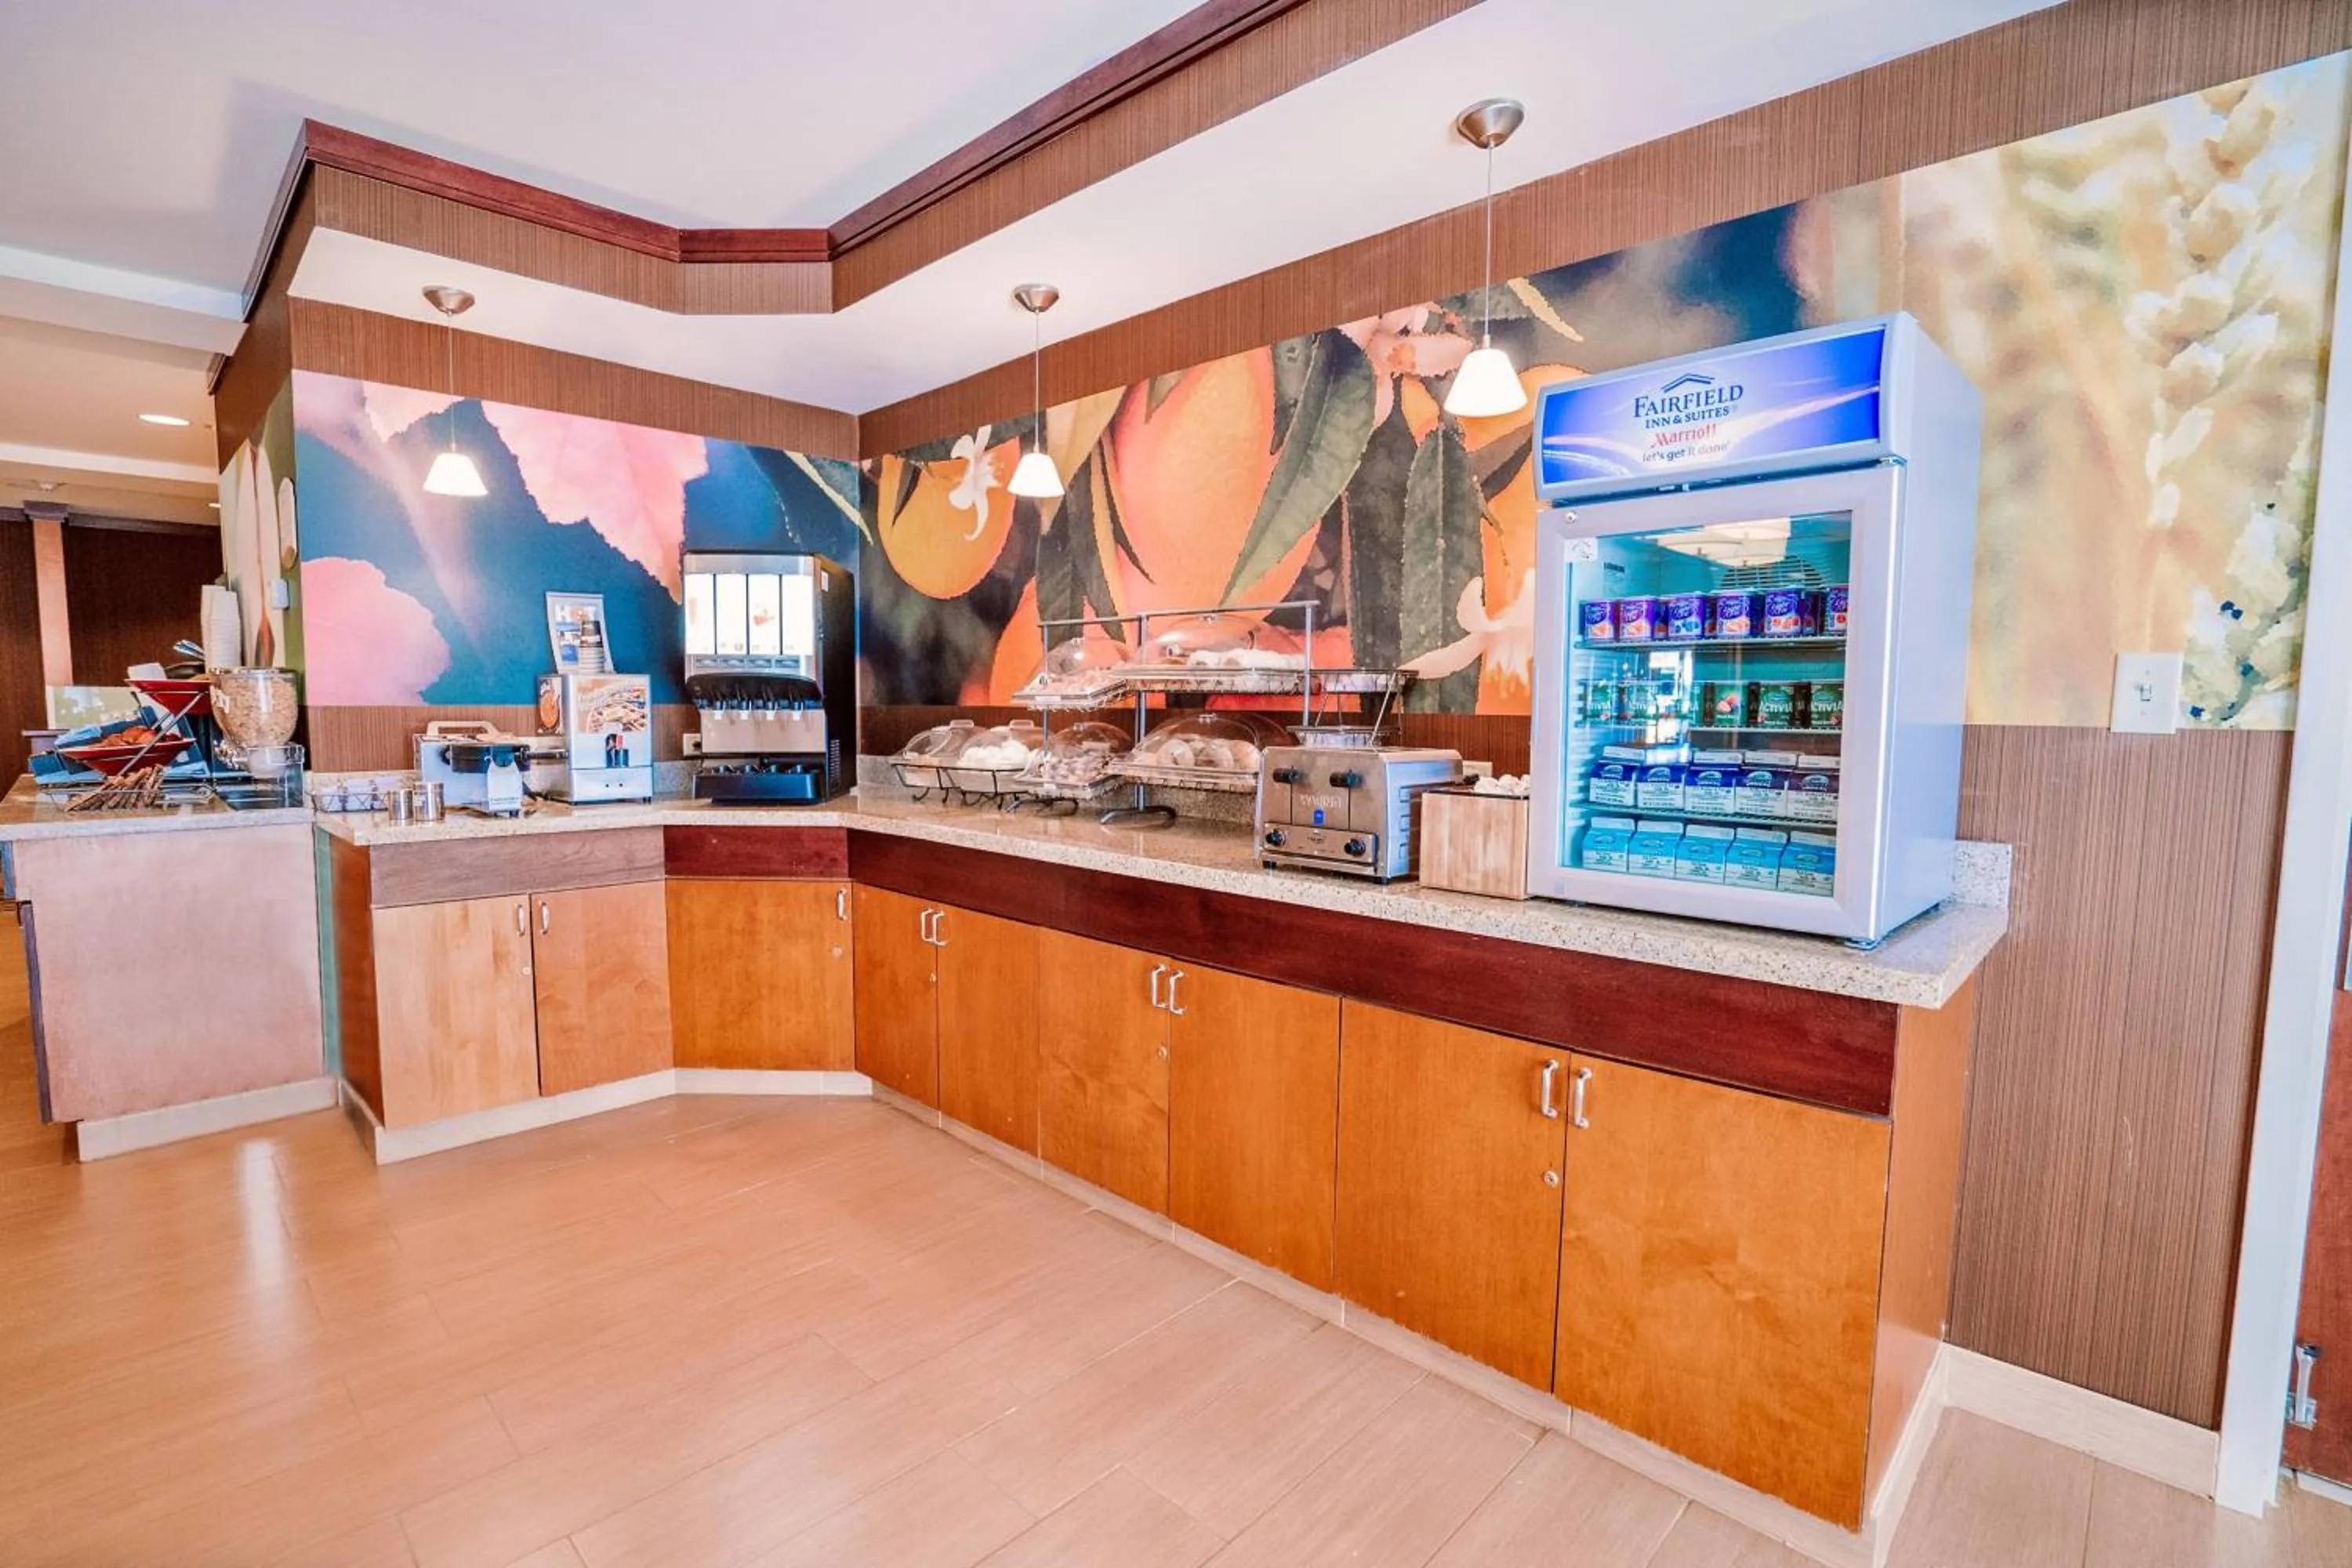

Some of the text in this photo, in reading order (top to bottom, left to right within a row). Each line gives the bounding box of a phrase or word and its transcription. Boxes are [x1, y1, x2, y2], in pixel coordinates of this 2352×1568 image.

[1633, 384, 1744, 418] FAIRFIELD
[1645, 405, 1731, 429] INN & SUITES
[1650, 423, 1717, 448] Marriott
[1666, 448, 1687, 461] get
